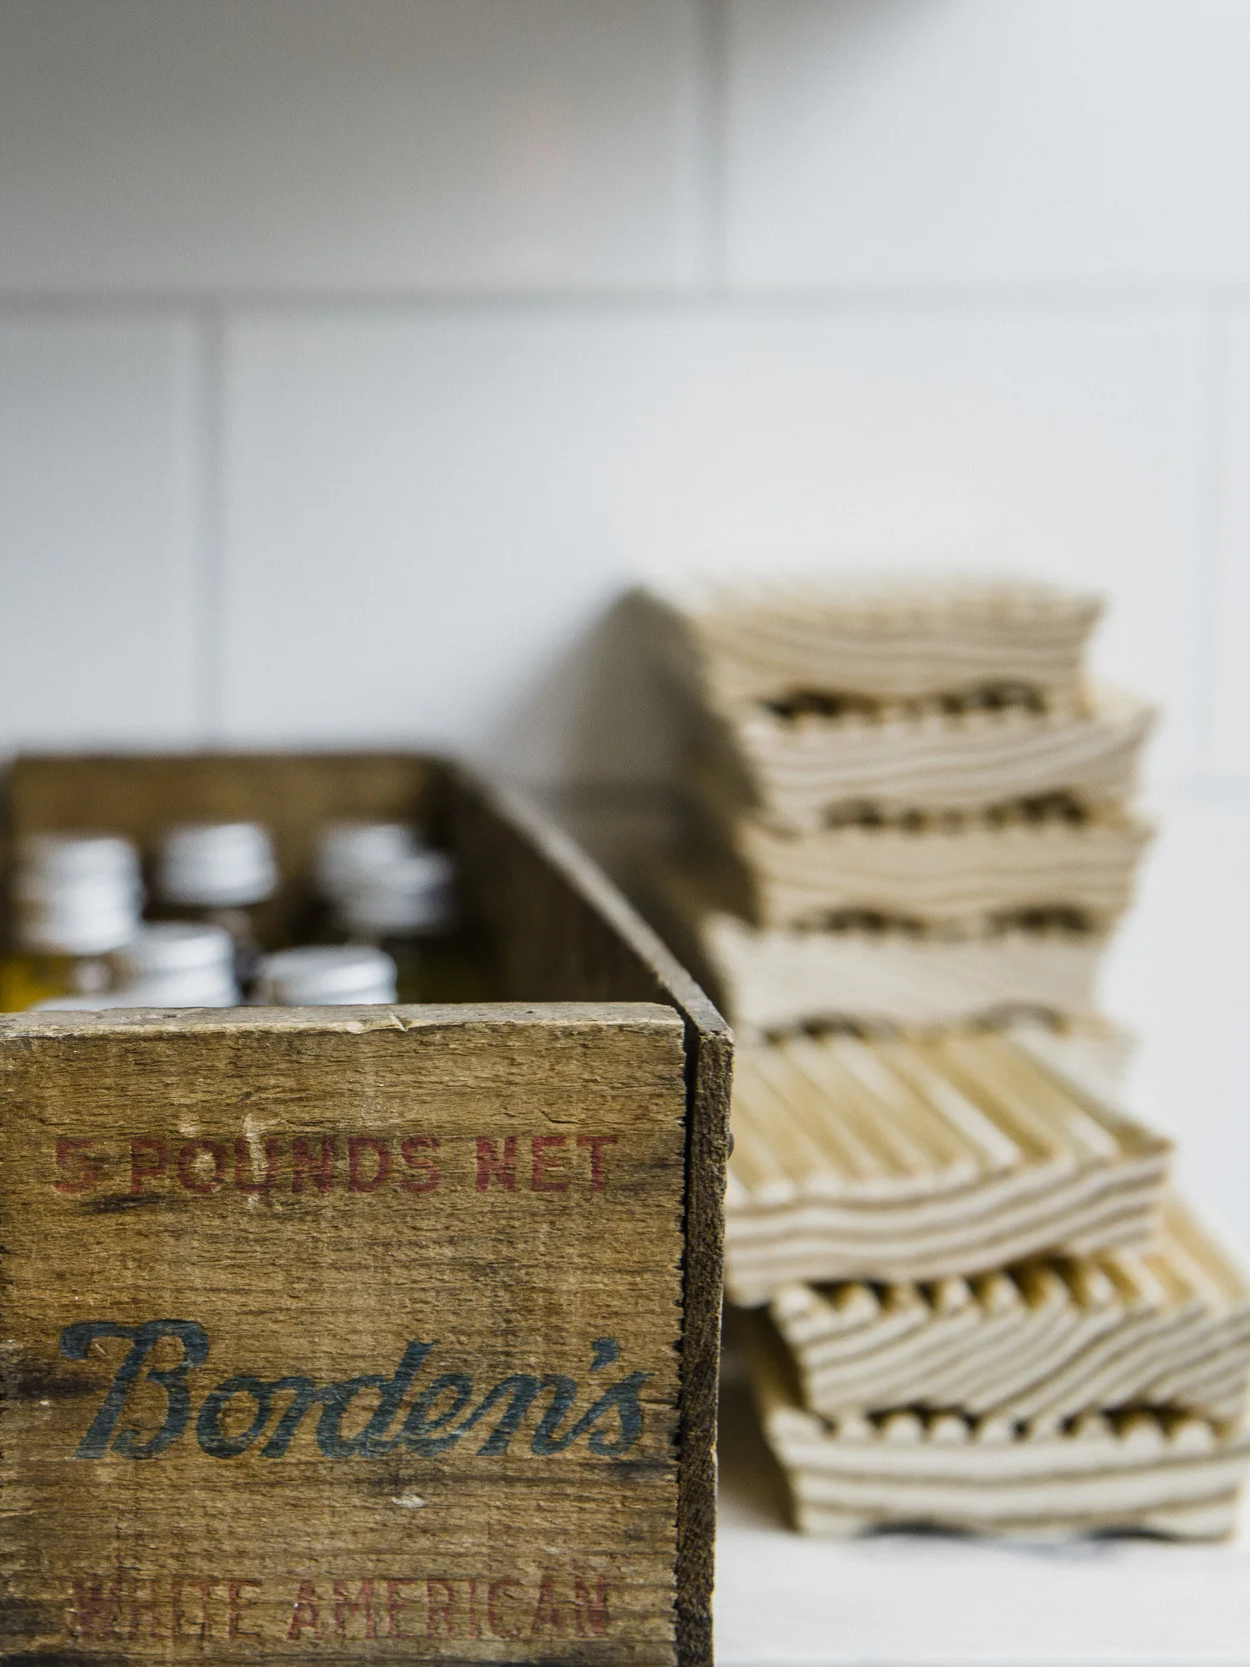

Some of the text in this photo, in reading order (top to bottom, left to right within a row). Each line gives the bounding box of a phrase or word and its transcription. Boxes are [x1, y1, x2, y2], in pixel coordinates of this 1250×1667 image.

[53, 1133, 620, 1195] 5 POUNDS NET
[58, 1318, 656, 1460] Borden's
[71, 1576, 611, 1642] WHITE AMERICAN
